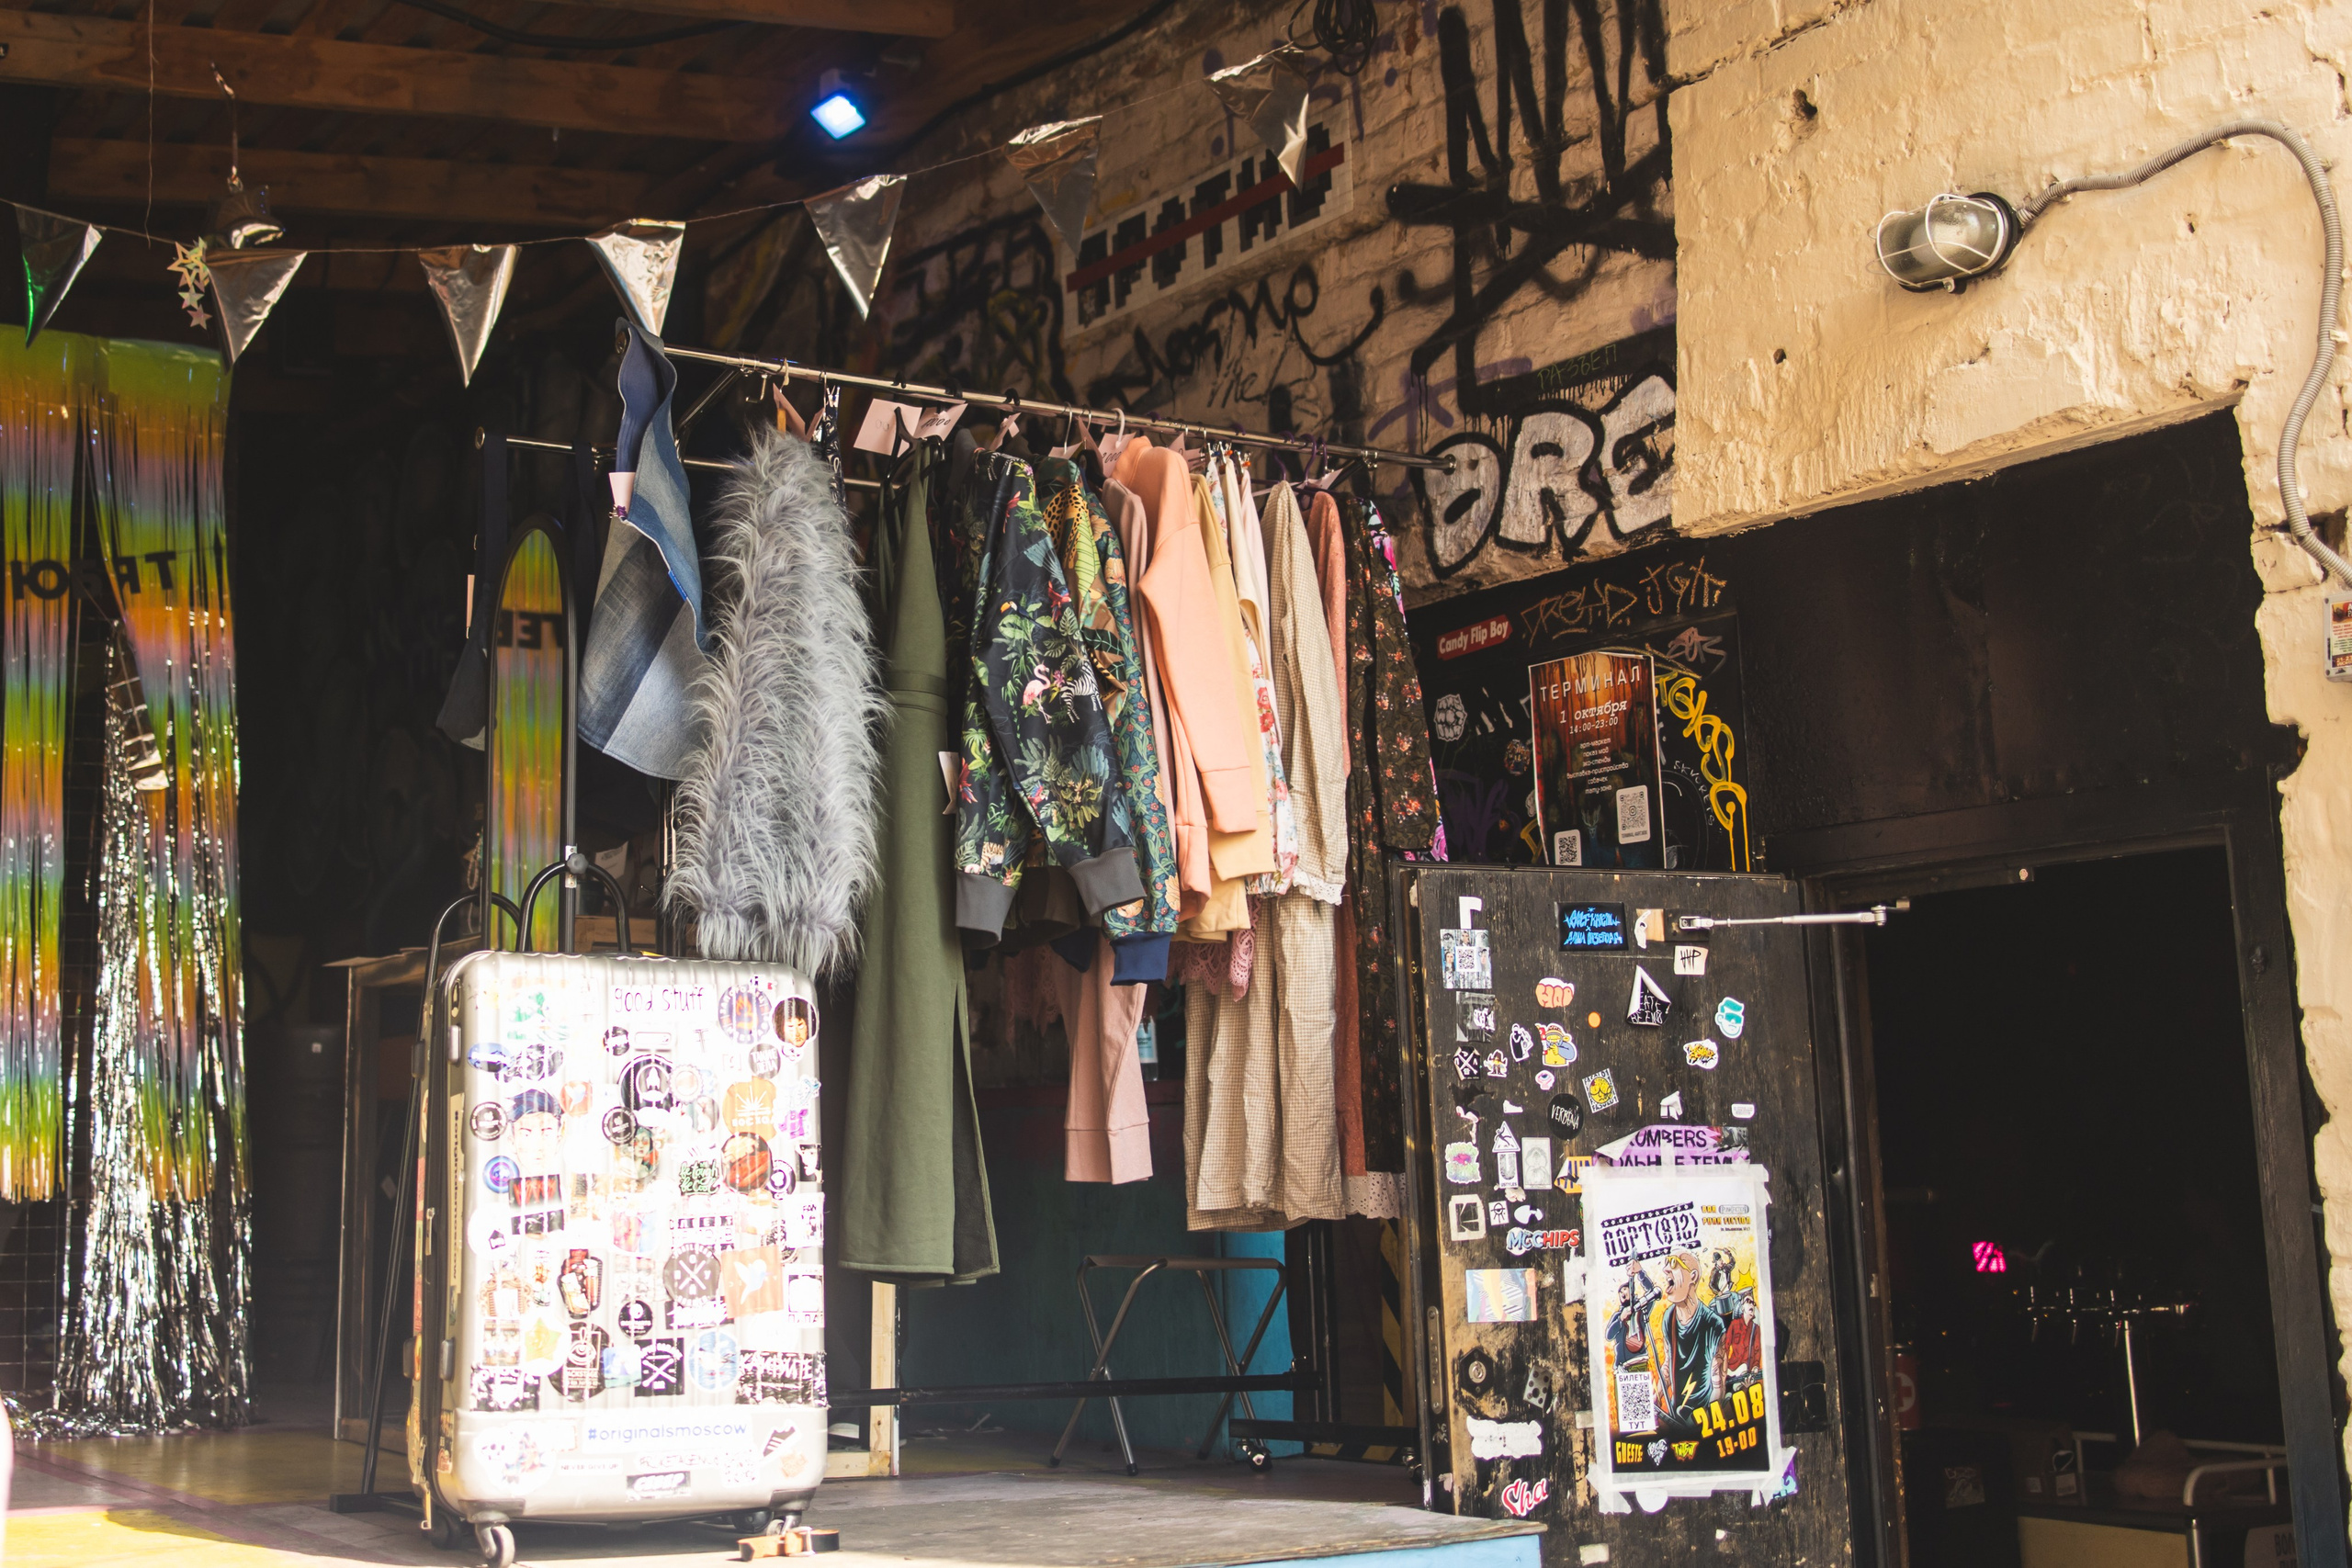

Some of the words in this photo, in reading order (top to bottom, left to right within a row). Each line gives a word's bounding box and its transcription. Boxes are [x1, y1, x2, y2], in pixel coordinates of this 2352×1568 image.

[1439, 633, 1468, 654] Candy
[1470, 626, 1487, 645] Flip
[1489, 620, 1509, 637] Boy
[1540, 665, 1640, 702] ТЕРМИНАЛ
[1560, 710, 1566, 724] 1
[1574, 700, 1627, 720] октября
[1569, 716, 1619, 734] 14:00-23:00
[1598, 746, 1609, 754] мод
[614, 987, 653, 1012] good
[751, 1048, 776, 1063] ТАКИЕ
[756, 1059, 777, 1074] ДЕЛА
[1629, 1129, 1707, 1147] UMBERS
[1619, 1373, 1650, 1382] БИЛЕТЫ
[1692, 1382, 1765, 1438] 24.08
[588, 1424, 747, 1443] #originalsmoscow
[1629, 1421, 1645, 1429] ТУТ
[1716, 1427, 1758, 1458] 19-00
[1615, 1441, 1644, 1464] GUESTS:
